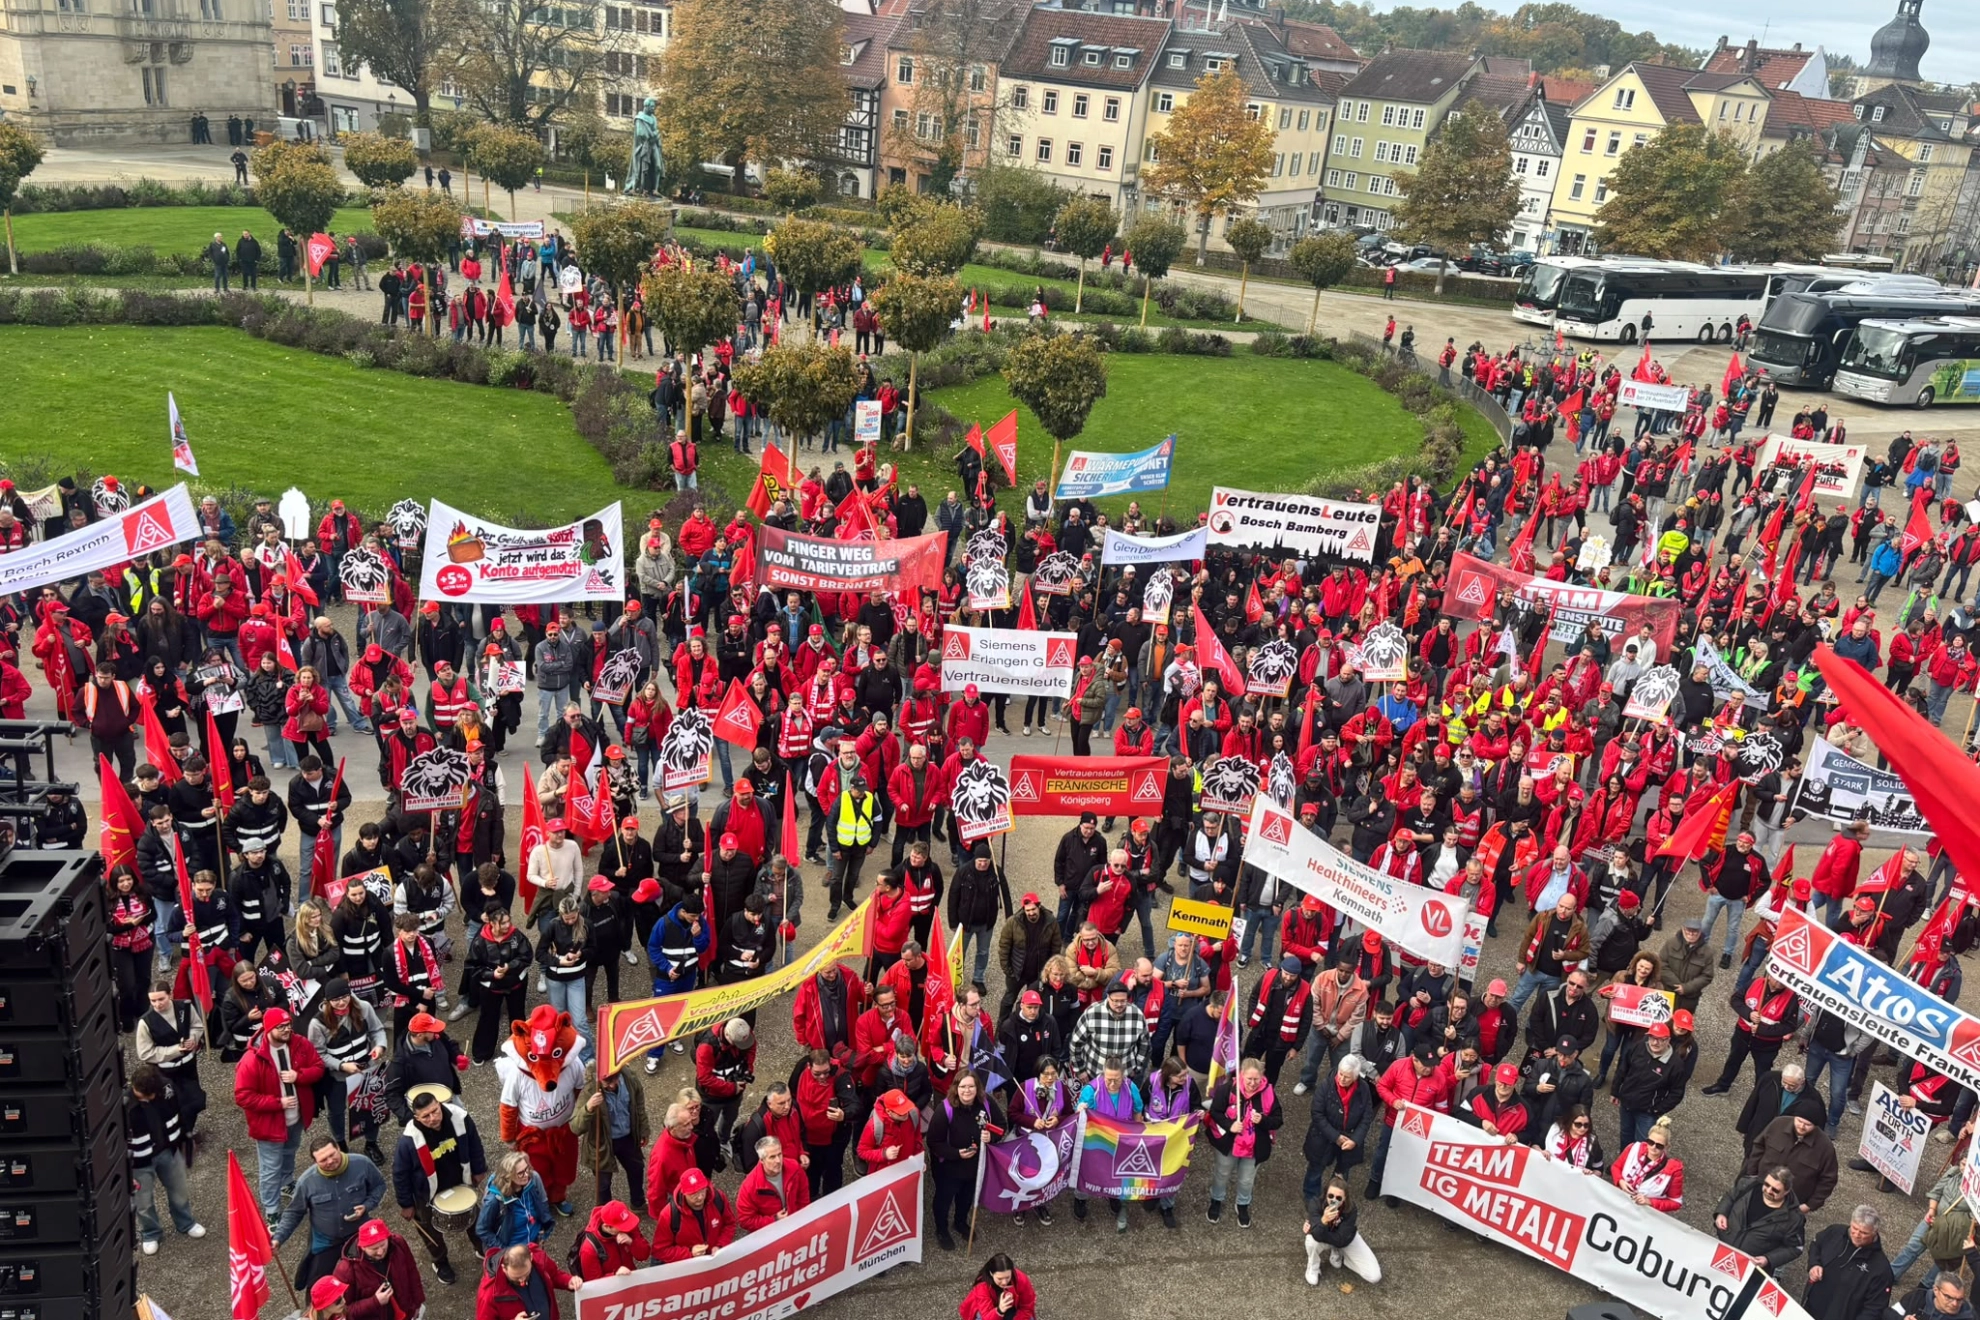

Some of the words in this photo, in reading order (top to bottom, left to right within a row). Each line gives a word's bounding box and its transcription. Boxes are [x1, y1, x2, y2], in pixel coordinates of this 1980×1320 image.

[1216, 492, 1378, 524] VertrauensLeute
[476, 526, 496, 540] Der
[1240, 515, 1282, 530] Bosch
[1286, 521, 1348, 539] Bamberg
[4, 557, 51, 578] Bosch
[56, 534, 110, 562] Rexroth
[497, 551, 523, 567] jetzt
[526, 549, 547, 562] wird
[550, 548, 566, 561] das
[787, 538, 836, 560] FINGER
[839, 545, 872, 561] WEG
[480, 563, 519, 579] Konto
[521, 560, 582, 579] aufgemotzt!
[764, 549, 795, 567] VOM
[801, 558, 896, 576] TARIFVERTRAG
[771, 569, 816, 587] SONST
[818, 577, 884, 590] BRENNTS!
[1521, 586, 1598, 609] TEAM
[979, 639, 1036, 652] Siemens
[970, 653, 1029, 668] Erlangen
[1033, 657, 1044, 667] G
[944, 670, 1068, 688] Vertrauensleute
[1047, 779, 1126, 791] FRÄNKISCHE
[1054, 768, 1125, 777] Vertrauensleute
[1833, 777, 1863, 791] STARK
[1060, 795, 1112, 806] Königsberg
[1306, 857, 1388, 911] Healthineers
[1335, 857, 1393, 895] SIEMENS
[1332, 888, 1384, 924] Kemnath
[1172, 909, 1228, 929] Kemnath
[688, 971, 798, 1018] Vertrauensleute
[1826, 955, 1949, 1039] Atos
[675, 982, 791, 1037] INNOMOTICS
[1433, 1142, 1517, 1179] TEAM
[1859, 1143, 1912, 1193] EVIDEN
[1084, 1182, 1101, 1193] WIR
[1103, 1187, 1122, 1195] SIND
[1425, 1171, 1458, 1198] IG
[1462, 1185, 1574, 1262] METALL
[858, 1243, 907, 1272] München
[1585, 1213, 1736, 1320] Coburg
[603, 1231, 829, 1320] Zusammenhalt
[741, 1258, 827, 1310] Stärke!
